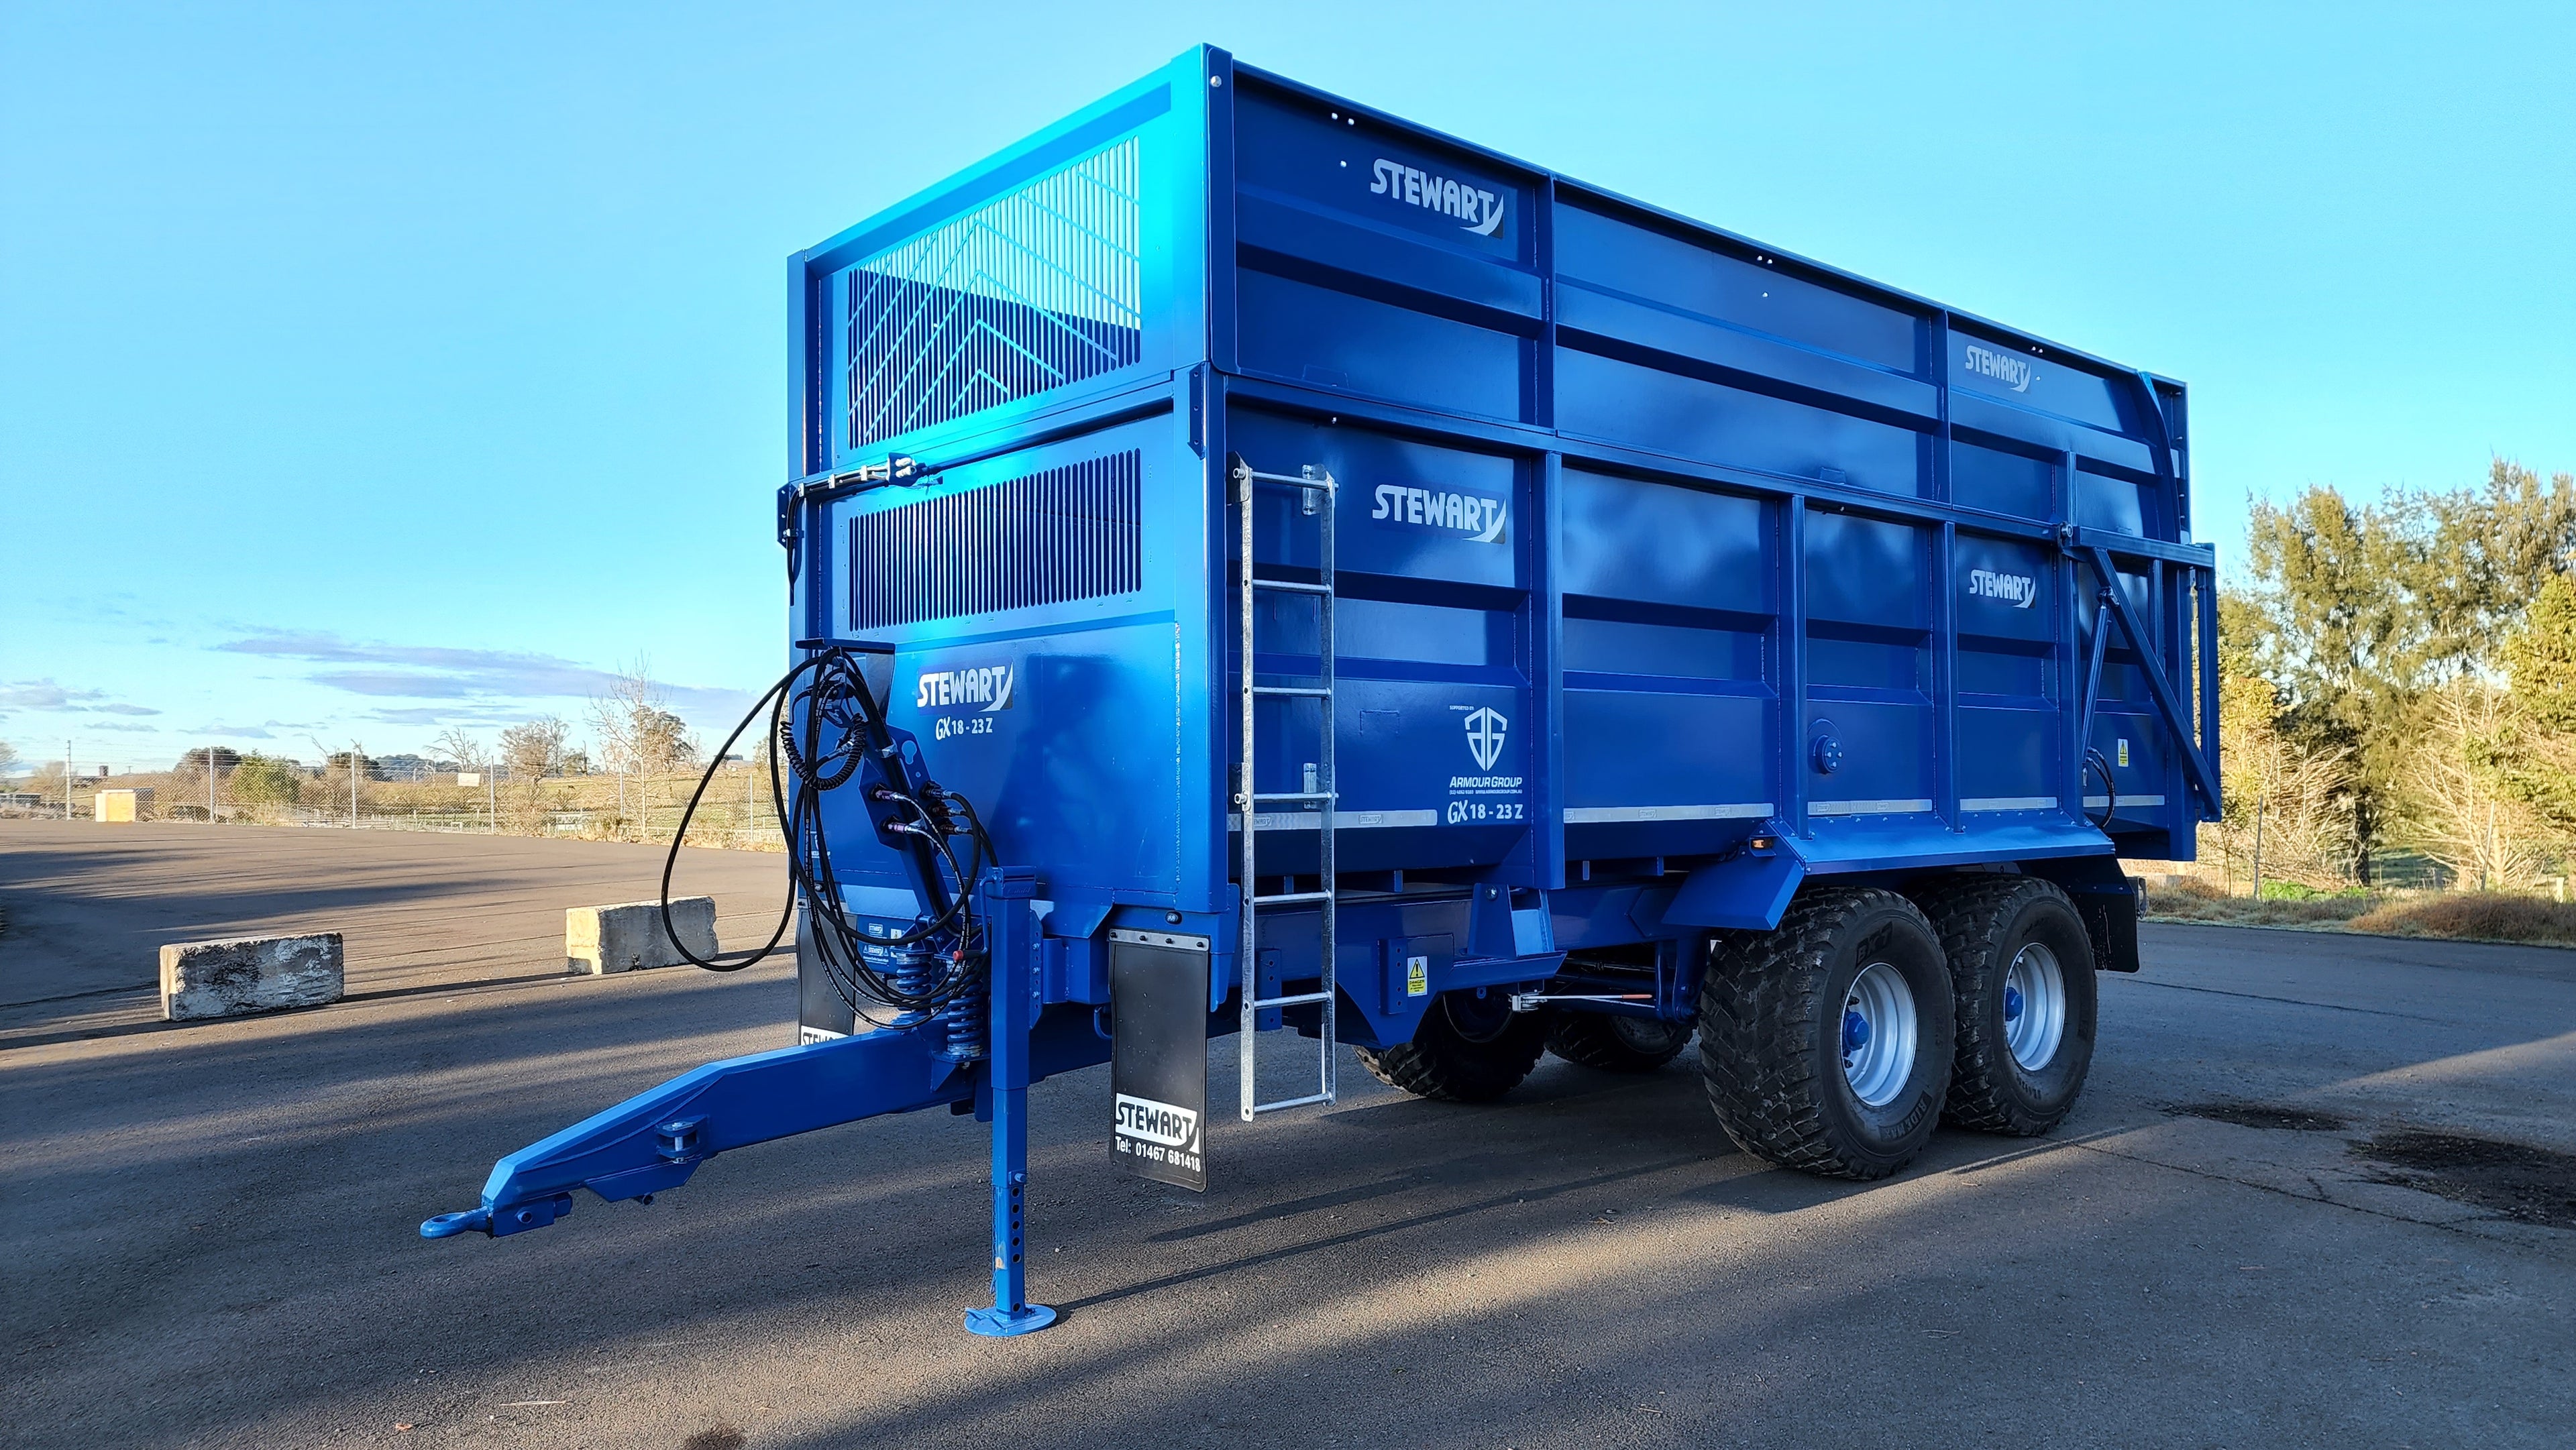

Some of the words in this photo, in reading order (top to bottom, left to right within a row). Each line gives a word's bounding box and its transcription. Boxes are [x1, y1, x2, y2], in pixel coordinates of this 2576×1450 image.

[1371, 158, 1503, 236] STEWART
[1966, 345, 2031, 392] STEWART
[1373, 484, 1507, 543] STEWART
[1970, 569, 2036, 608] STEWART
[918, 662, 1014, 712] STEWART
[1116, 1101, 1198, 1150] STEWART
[1115, 1135, 1132, 1154] Tel:
[1136, 1141, 1166, 1162] 01467
[1167, 1149, 1201, 1172] 681418
